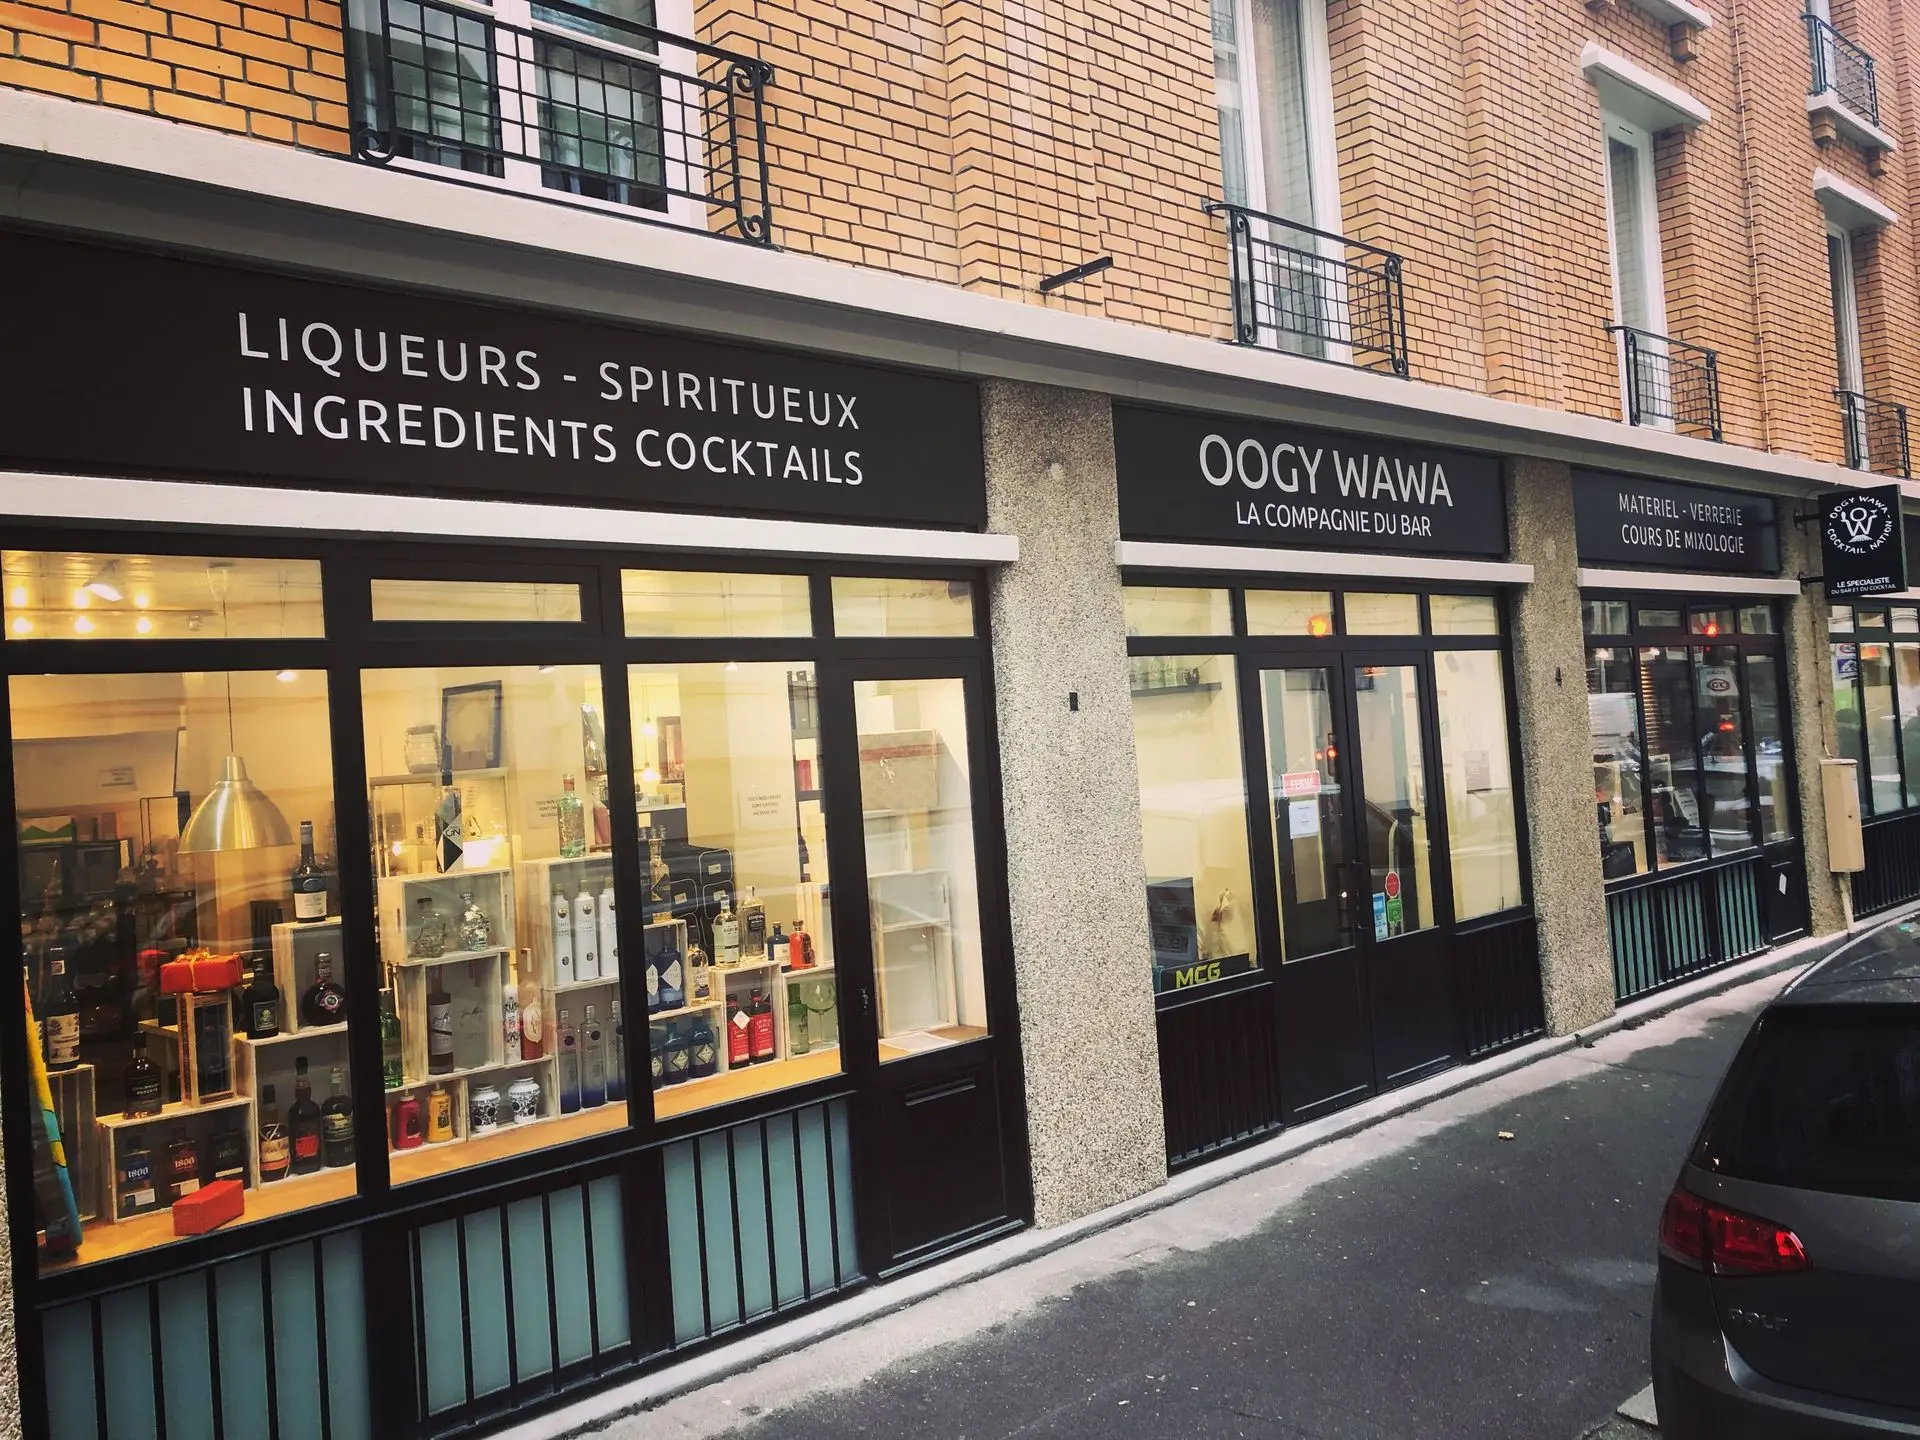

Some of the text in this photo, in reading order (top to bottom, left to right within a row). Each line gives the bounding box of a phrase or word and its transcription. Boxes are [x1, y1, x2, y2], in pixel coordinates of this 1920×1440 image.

[238, 312, 860, 430] LIQUEURS - SPIRITUEUX
[243, 386, 863, 486] INGREDIENTS COCKTAILS
[1199, 433, 1454, 507] OOGY WAWA
[1236, 500, 1432, 537] LA COMPAGNIE DU BAR
[1618, 492, 1680, 519] MATERIEL
[1689, 501, 1744, 526] VERRERIE
[1829, 497, 1855, 519] OOGY
[1858, 495, 1888, 514] WAWA
[1621, 523, 1745, 554] COURS DE MIXOLOGIE
[1827, 528, 1867, 554] COCKTAIL
[1869, 520, 1893, 551] NATION
[1846, 577, 1890, 588] SPECIALISTE
[1869, 583, 1897, 591] COCKTAIL
[1175, 961, 1221, 989] MCG
[128, 1166, 149, 1179] 1800
[175, 1156, 195, 1169] 1800
